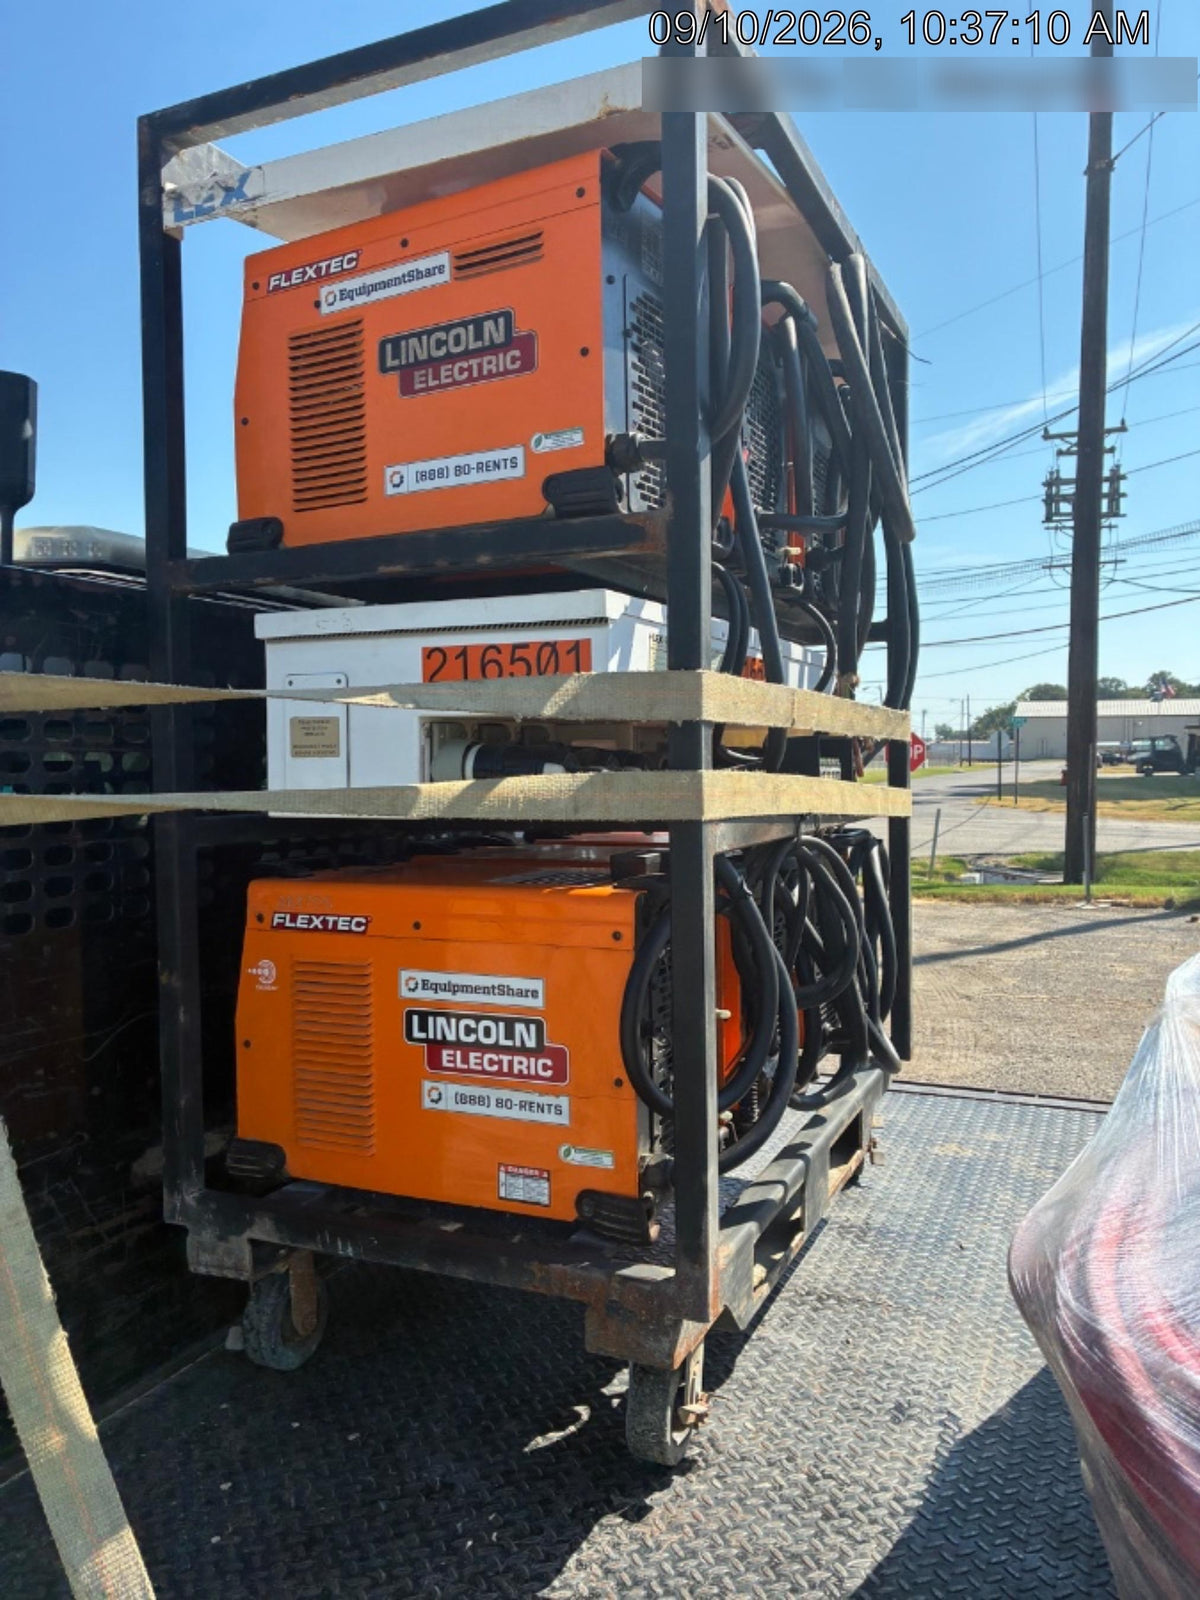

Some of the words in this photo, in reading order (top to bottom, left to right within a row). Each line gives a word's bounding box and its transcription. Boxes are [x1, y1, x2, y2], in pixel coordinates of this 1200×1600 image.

[268, 252, 358, 291] FLEXTEC
[338, 263, 446, 301] EquipmentShare
[385, 316, 506, 369] LINCOLN
[413, 350, 522, 390] ELECTRIC
[415, 466, 449, 484] (888)
[454, 456, 518, 478] 80-RENTS
[272, 913, 367, 933] FLEXTEC
[421, 978, 539, 999] EquipmentShare
[411, 1014, 537, 1048] LINCOLN
[441, 1050, 553, 1077] ELECTRIC
[454, 1091, 491, 1109] (888)
[495, 1097, 563, 1116] 80-RENTS
[507, 1166, 540, 1177] DANGER
